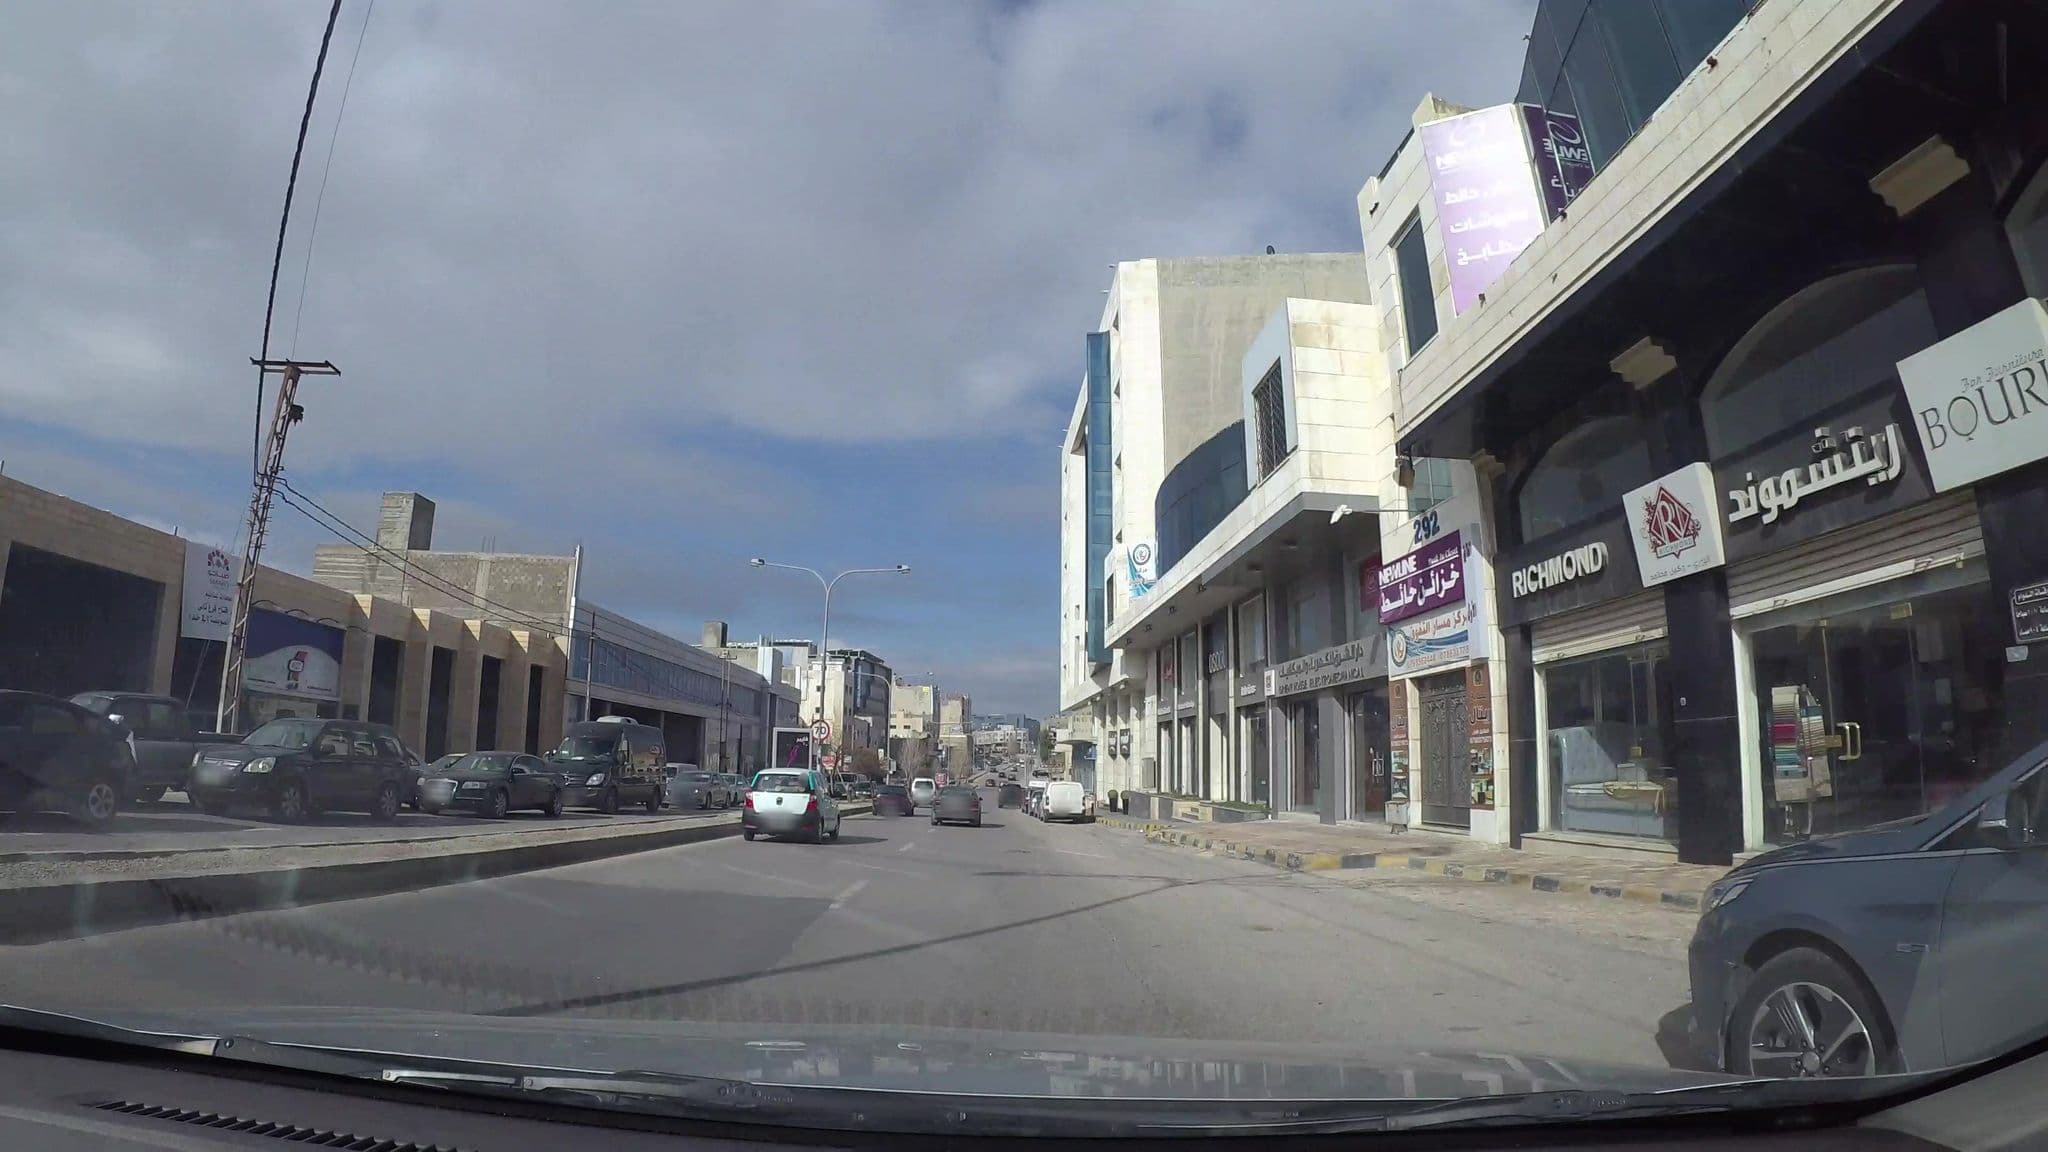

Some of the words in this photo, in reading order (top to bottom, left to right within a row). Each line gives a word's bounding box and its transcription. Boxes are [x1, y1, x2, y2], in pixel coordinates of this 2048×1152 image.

[1728, 422, 1901, 525] ريتشموند
[1413, 510, 1440, 545] 292
[1379, 555, 1418, 586] NEWLINE
[1417, 563, 1461, 607] خزائن
[1512, 541, 1608, 599] RICHMOND
[1380, 583, 1417, 613] حائط
[814, 726, 827, 735] 70
